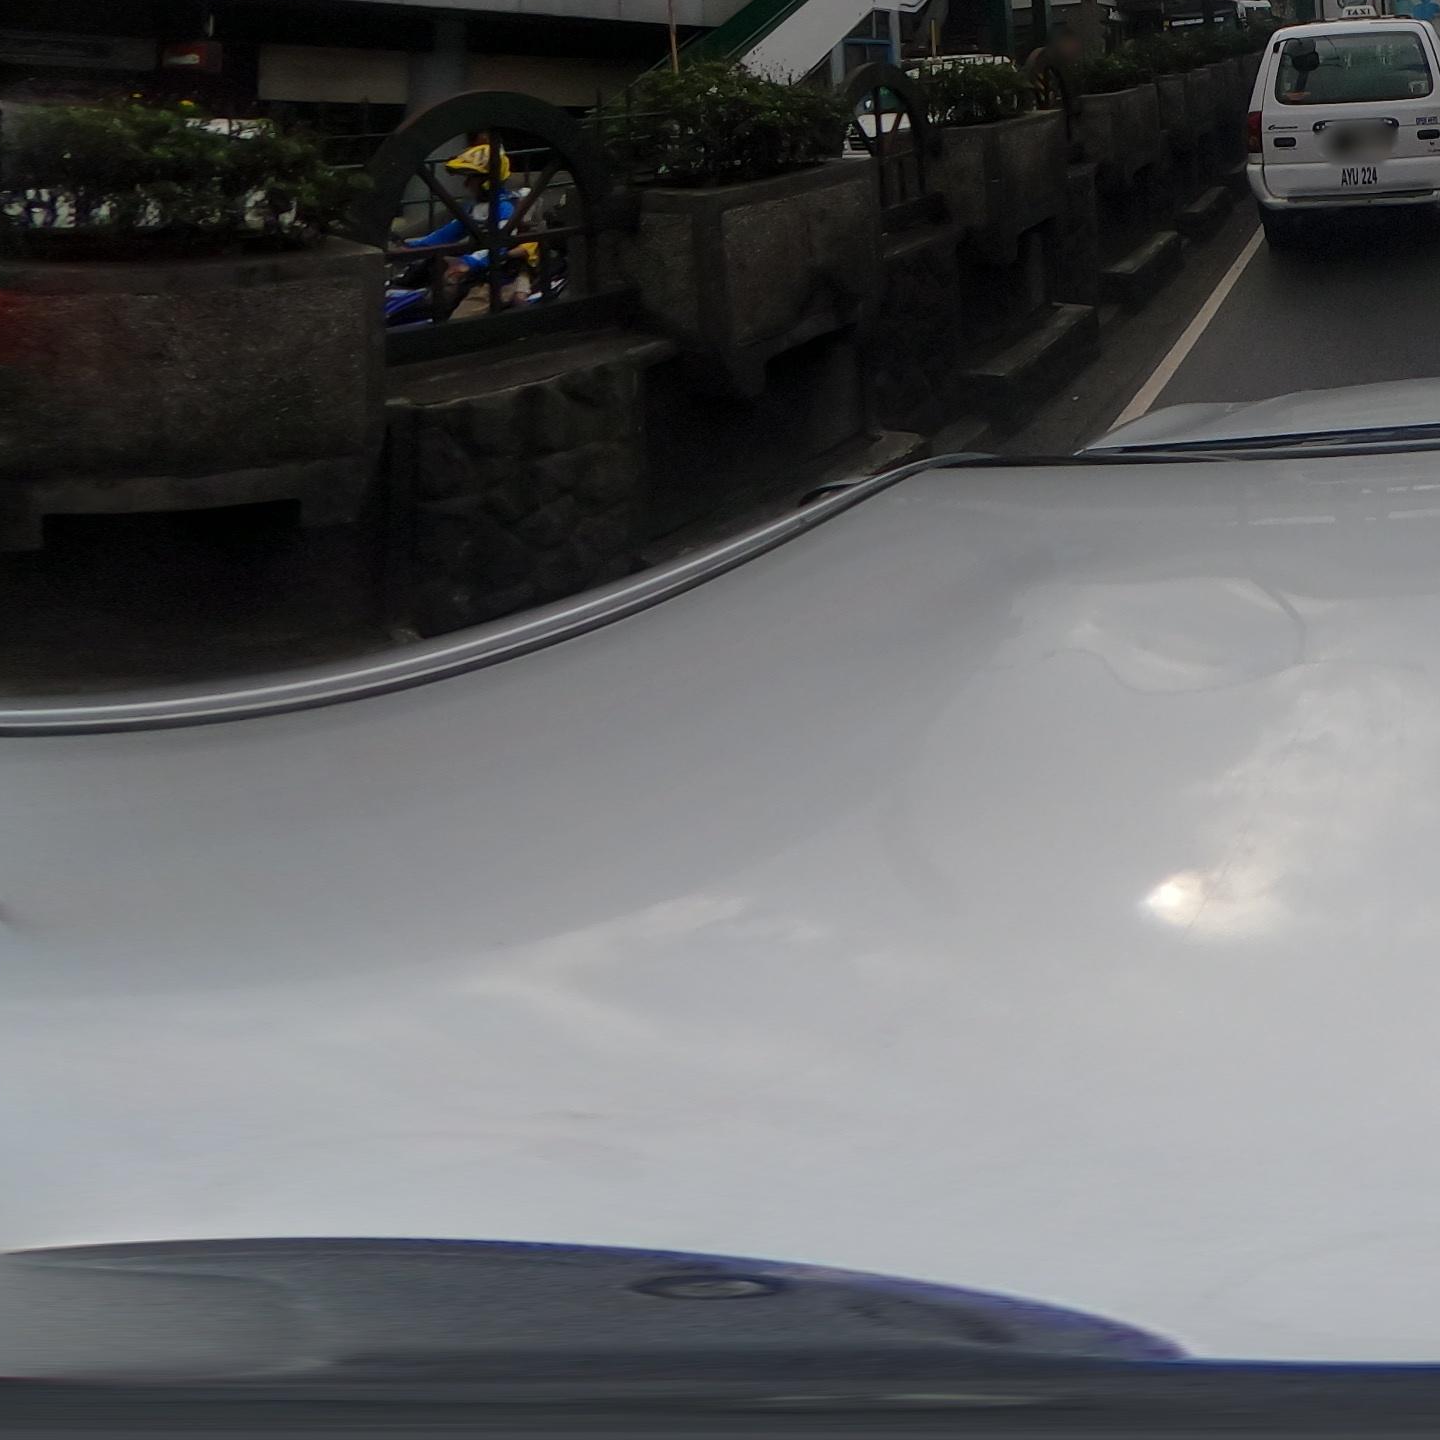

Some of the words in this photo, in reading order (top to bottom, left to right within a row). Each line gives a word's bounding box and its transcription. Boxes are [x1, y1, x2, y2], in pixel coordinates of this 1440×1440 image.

[1346, 8, 1371, 16] TAXI
[1341, 167, 1359, 187] AYU
[1361, 167, 1378, 185] 224
